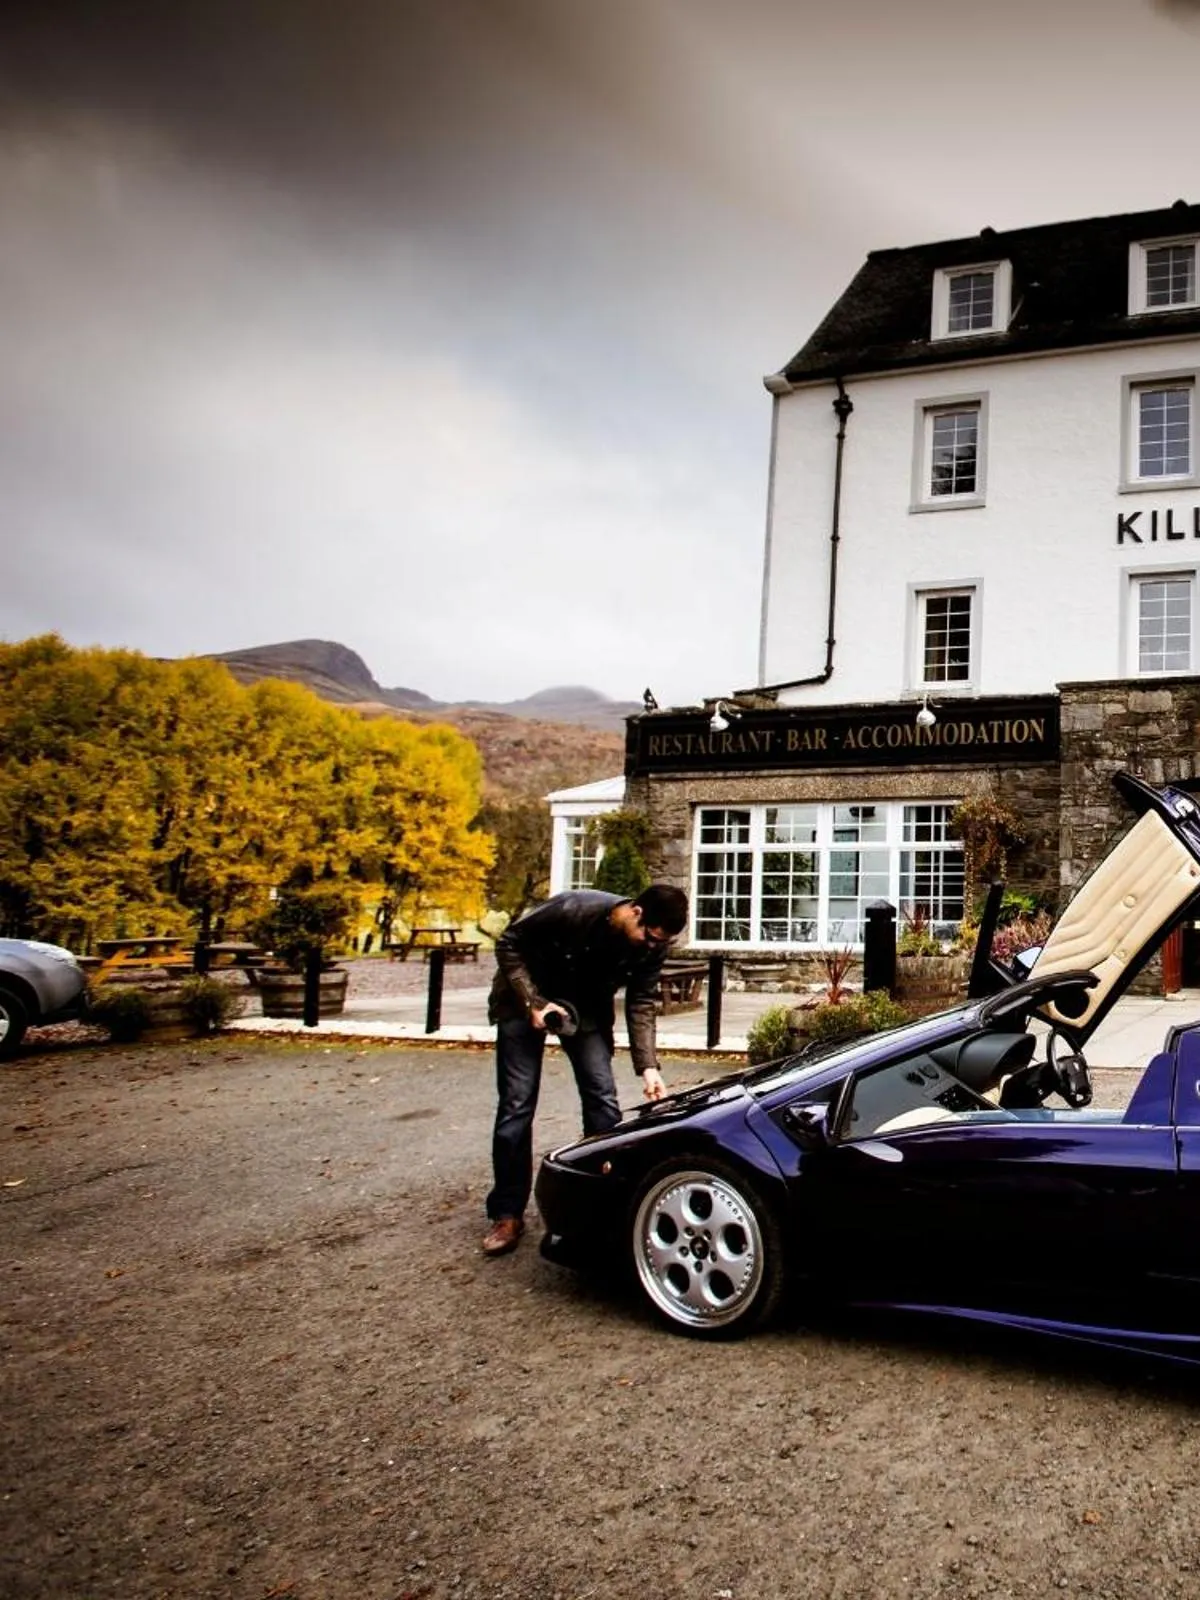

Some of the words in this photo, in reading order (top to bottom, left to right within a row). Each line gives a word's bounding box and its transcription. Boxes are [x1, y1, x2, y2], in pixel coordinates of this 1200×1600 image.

[648, 729, 776, 756] RESTAURANT
[786, 728, 827, 751] BAR
[842, 718, 1045, 749] ACCOMMODATION
